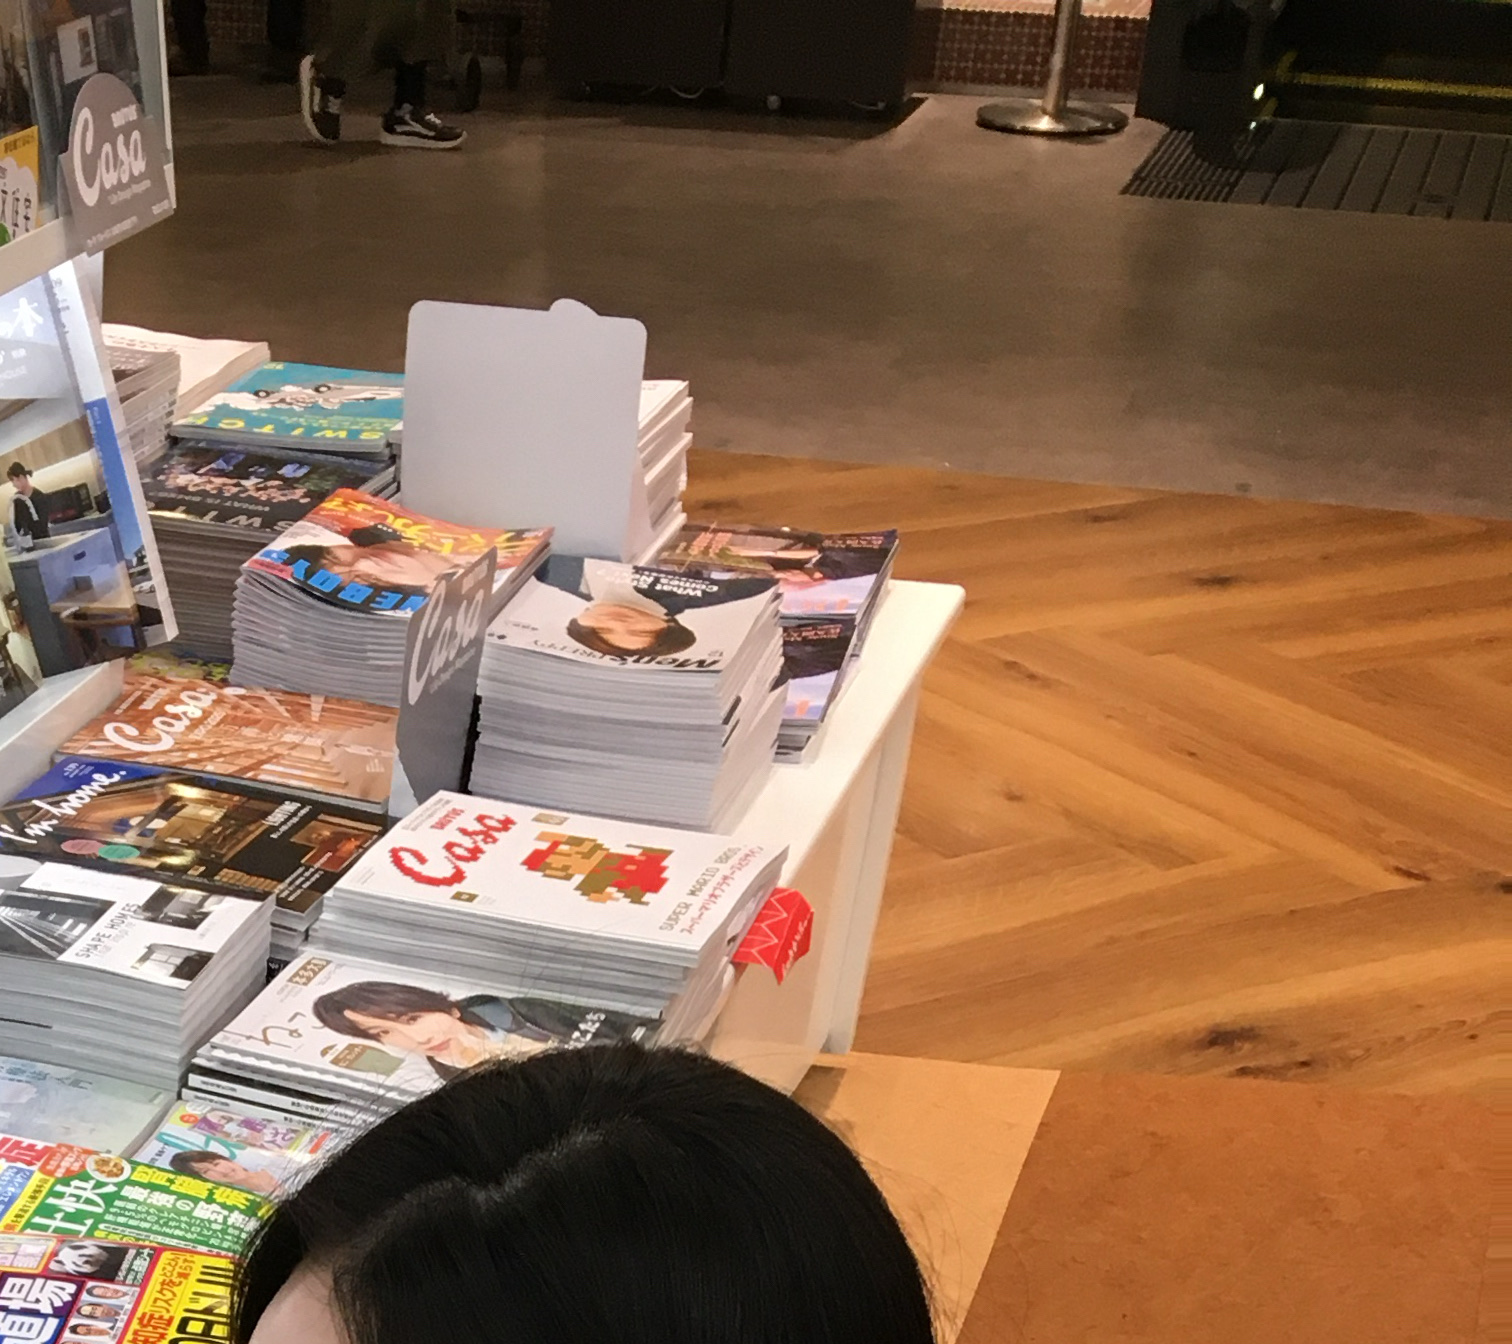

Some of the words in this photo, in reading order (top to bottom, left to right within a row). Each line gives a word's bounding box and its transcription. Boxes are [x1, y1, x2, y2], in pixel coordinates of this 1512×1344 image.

[74, 107, 146, 206] Casa
[408, 579, 486, 705] Casa
[104, 686, 217, 751] Casa
[388, 812, 518, 887] Casa
[659, 901, 694, 932] SUPER
[689, 867, 719, 899] MARIO
[74, 924, 110, 958] SHAPE
